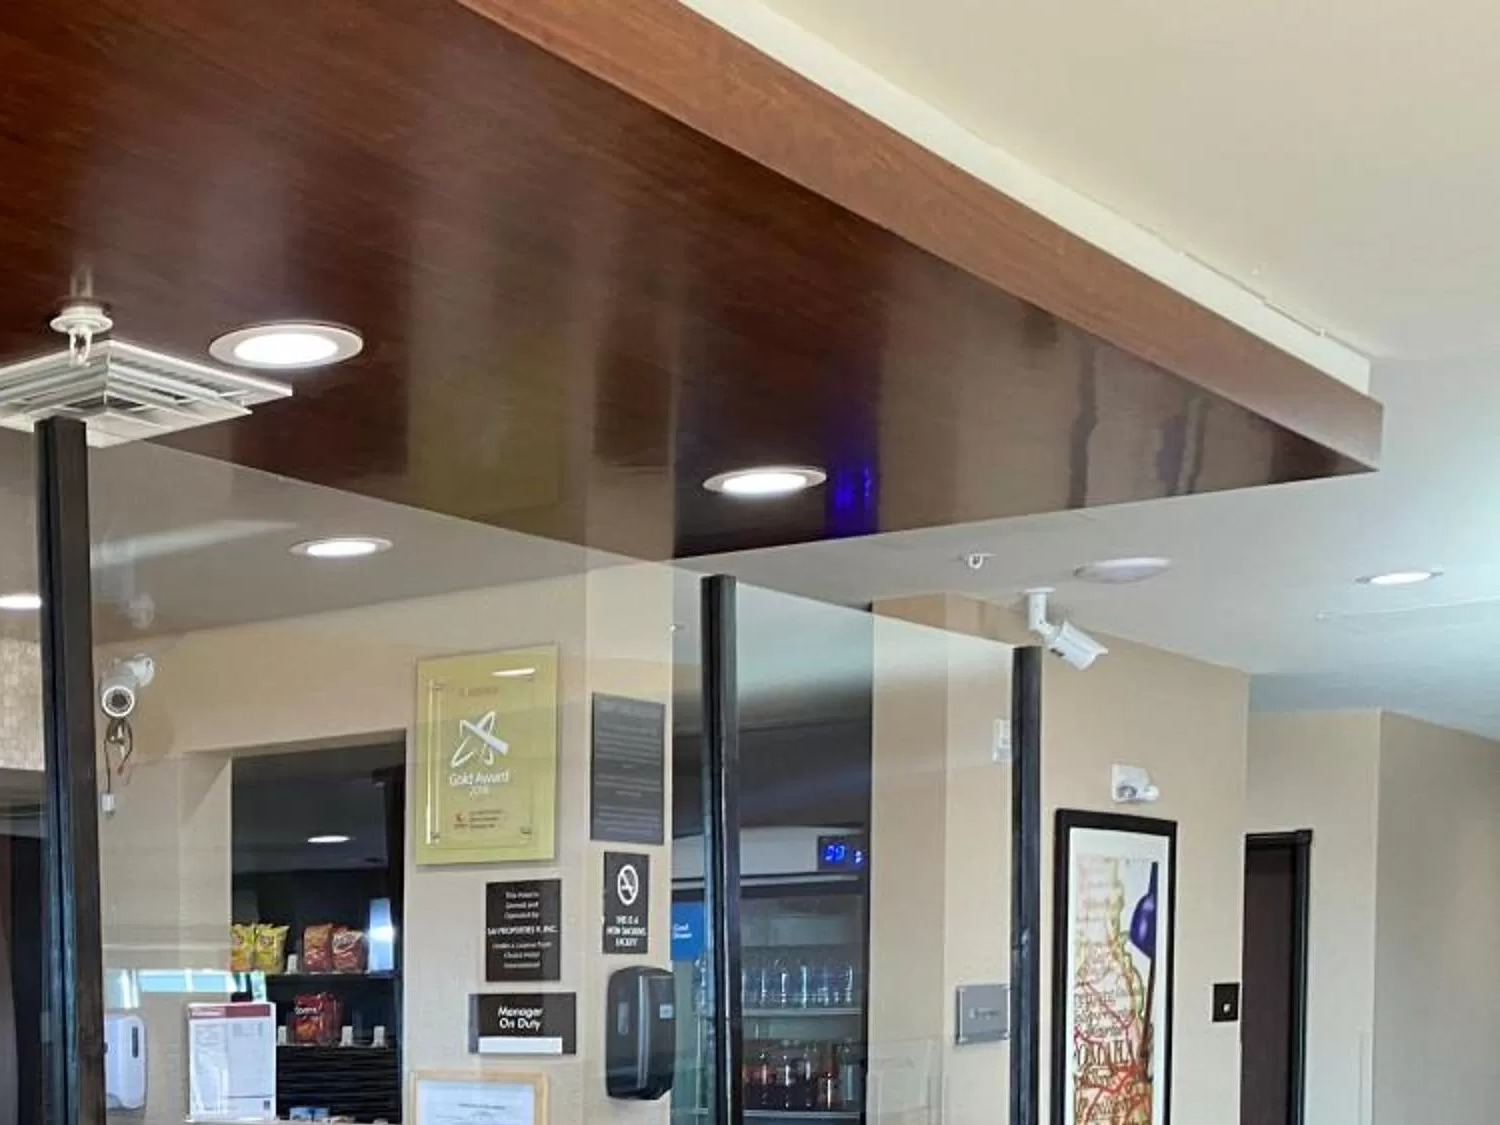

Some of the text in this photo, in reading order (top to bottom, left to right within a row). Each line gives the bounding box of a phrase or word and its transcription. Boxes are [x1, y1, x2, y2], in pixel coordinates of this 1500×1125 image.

[448, 771, 472, 786] Gold
[497, 1005, 544, 1019] Manager
[499, 1018, 541, 1032] On Duty
